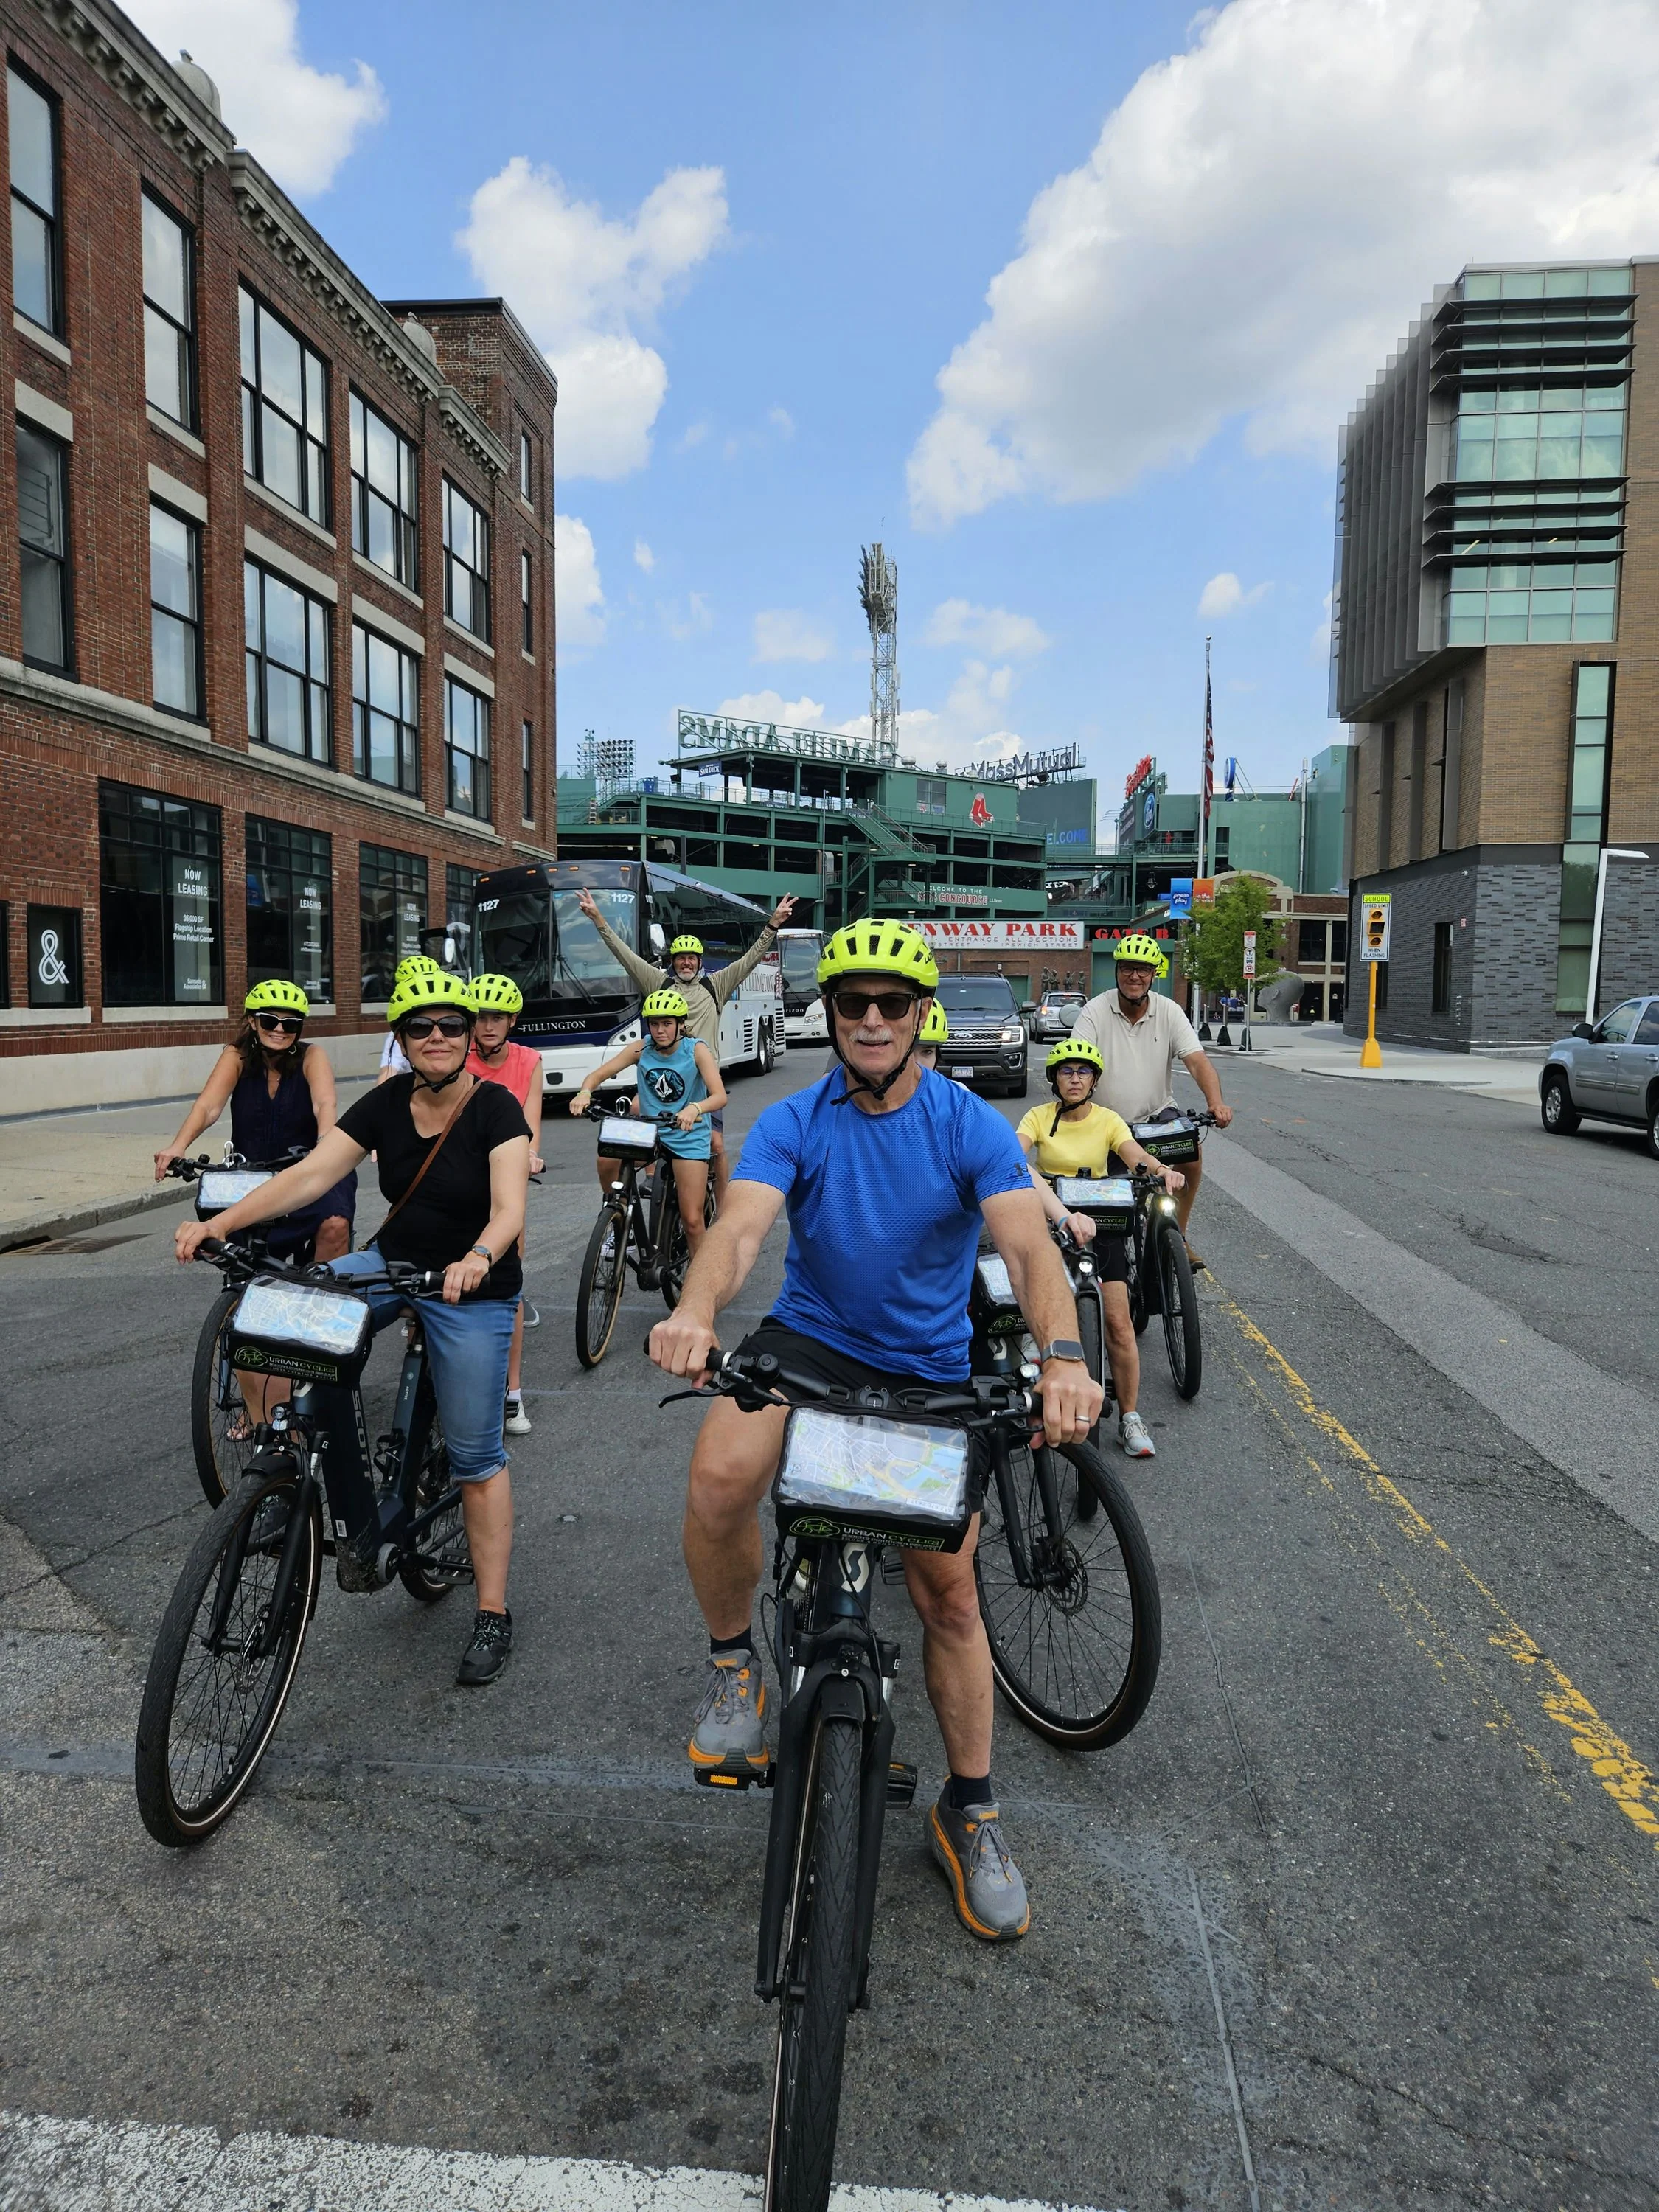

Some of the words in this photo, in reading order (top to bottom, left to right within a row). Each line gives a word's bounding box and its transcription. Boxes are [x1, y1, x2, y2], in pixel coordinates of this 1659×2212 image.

[971, 742, 1077, 781] MassMutual
[1046, 828, 1088, 846] ELCOME
[184, 869, 201, 881] NOW
[178, 883, 208, 897] LEASING
[304, 887, 317, 897] NOW
[612, 893, 635, 904] 1127
[939, 892, 988, 906] CONCOURSE
[1174, 897, 1188, 905] play
[299, 899, 321, 911] LEASING
[478, 899, 500, 912] 1127
[175, 922, 193, 933] Flagship
[193, 925, 212, 933] Location
[907, 923, 995, 936] ENWAY
[1006, 923, 1078, 936] PARK
[1155, 928, 1169, 939] B
[173, 932, 187, 942] Prime
[187, 933, 200, 942] Retail
[522, 1020, 586, 1032] FULLINGTON
[269, 1357, 299, 1367] URBAN
[843, 1527, 887, 1539] URBAN
